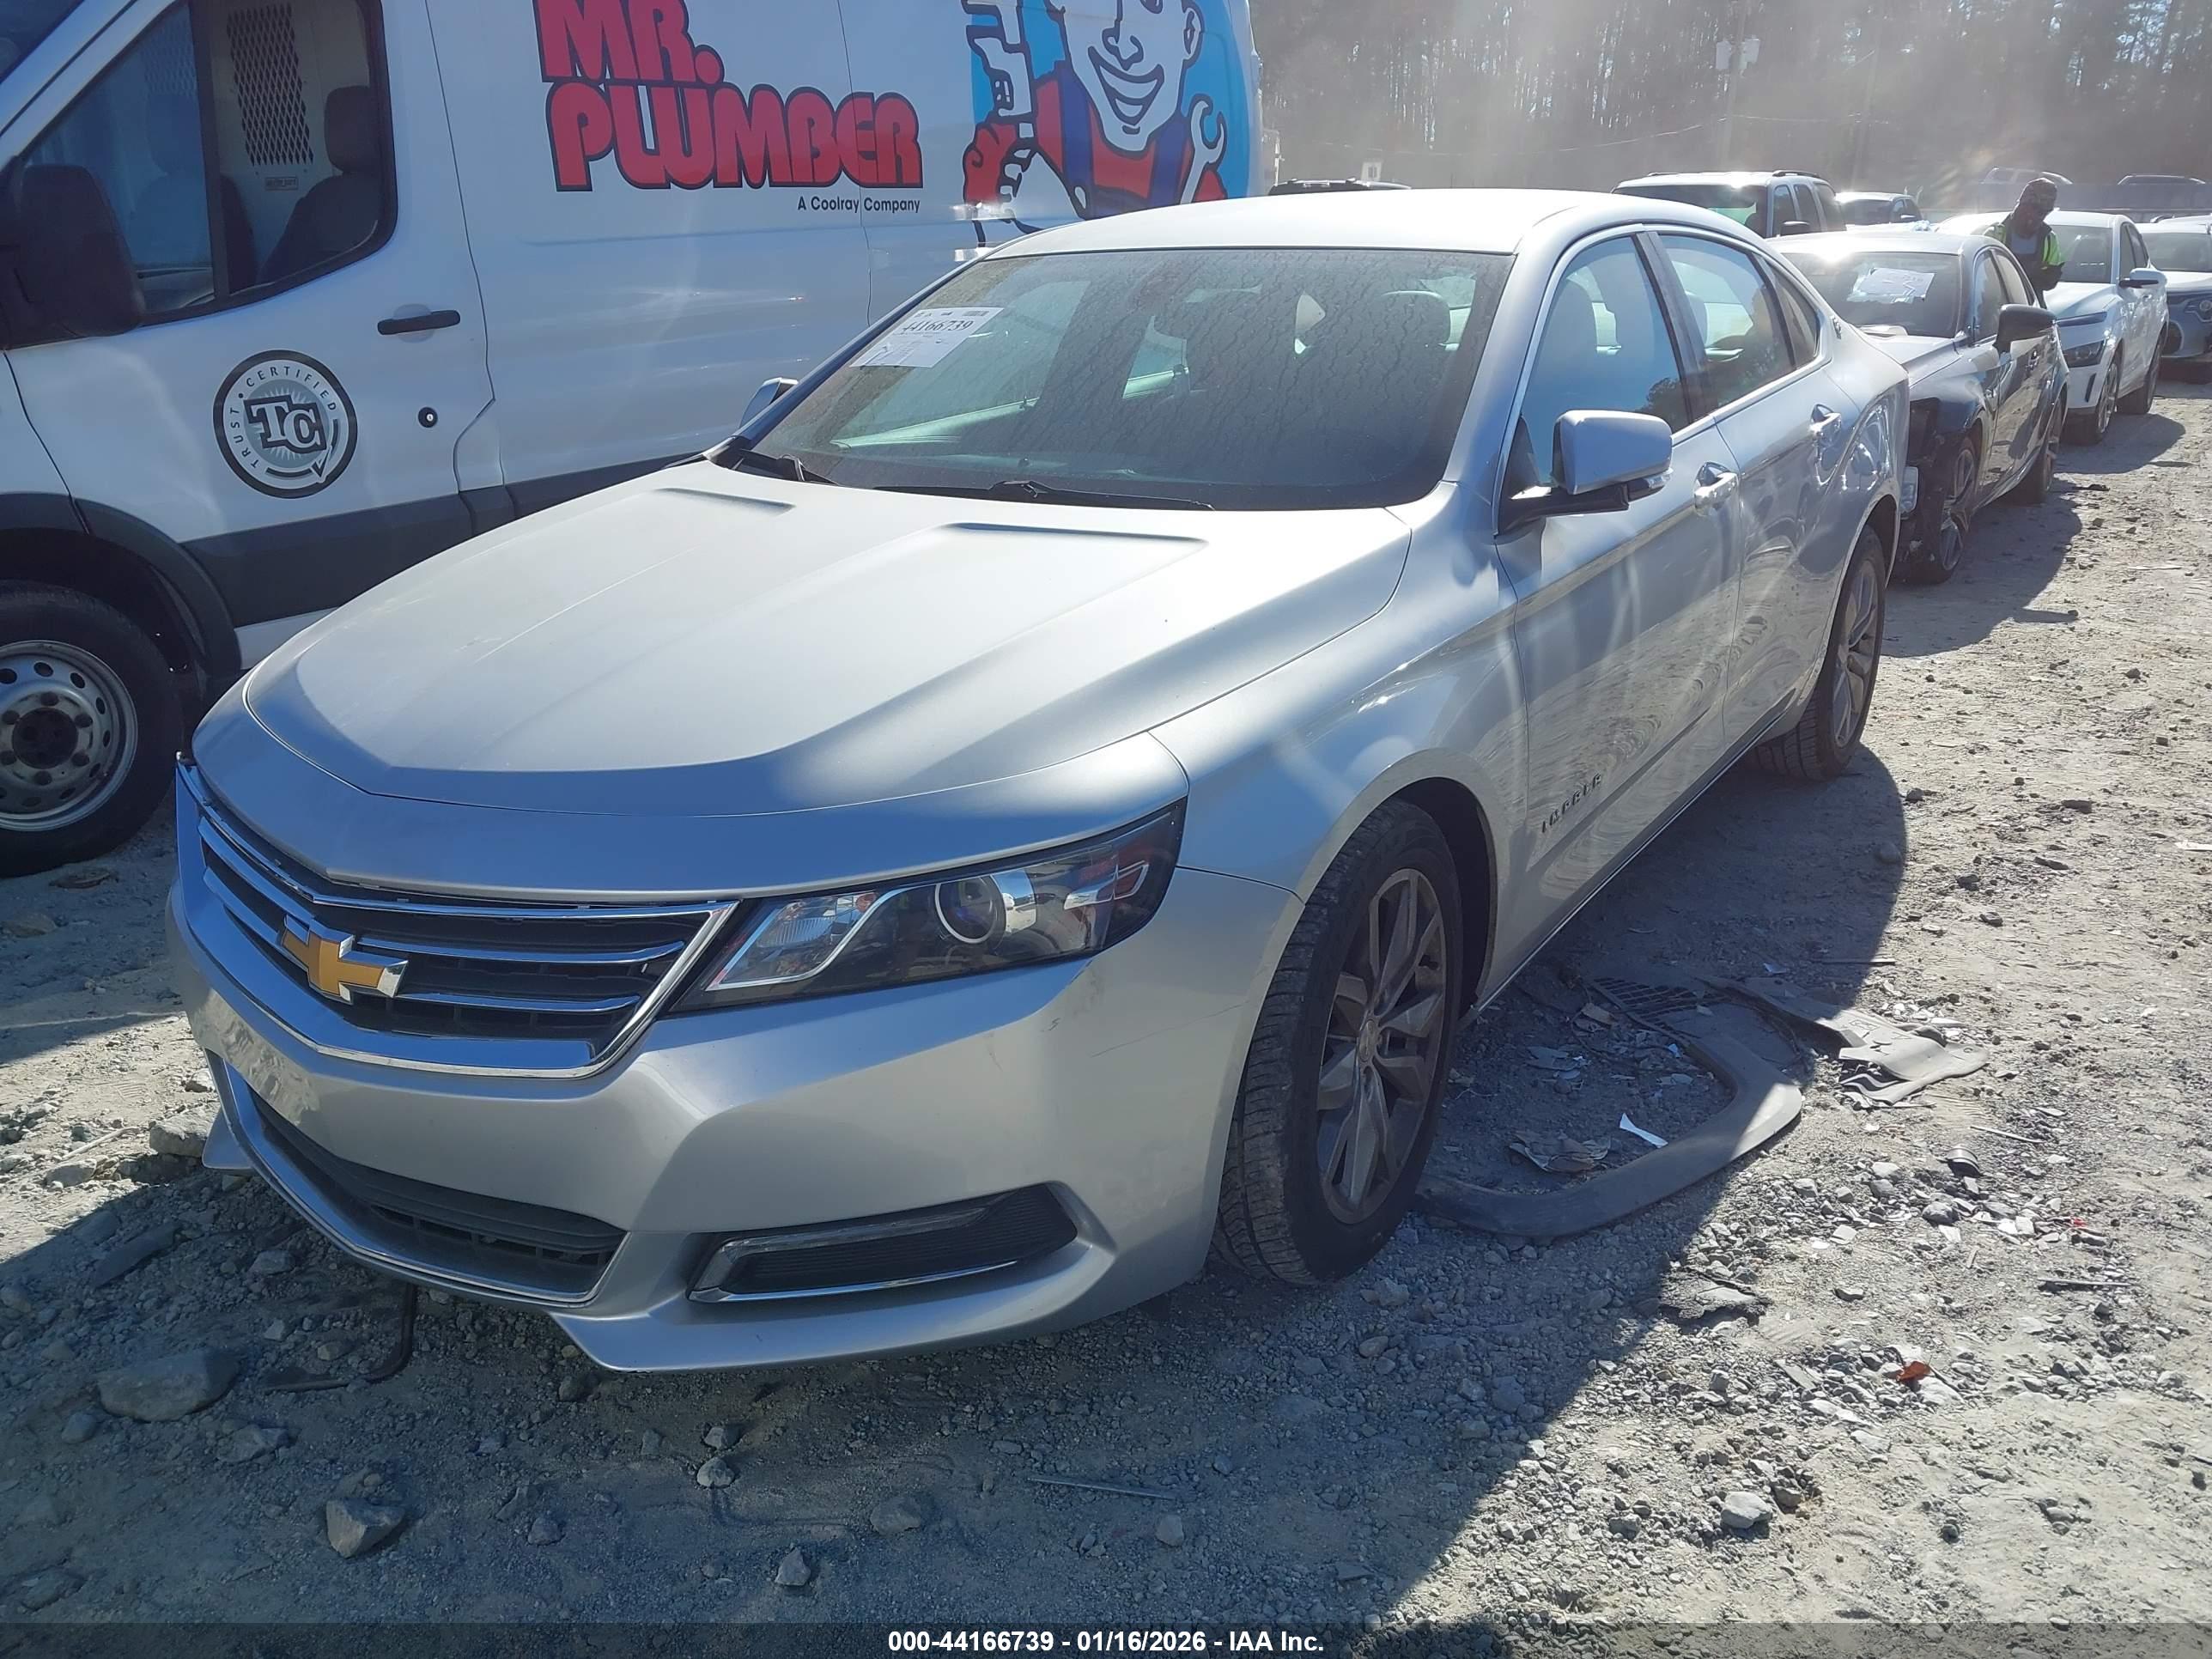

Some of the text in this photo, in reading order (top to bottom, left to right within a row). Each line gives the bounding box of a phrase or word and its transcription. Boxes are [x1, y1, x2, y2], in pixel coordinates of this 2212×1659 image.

[532, 0, 725, 84] MR.
[545, 81, 923, 192] PLUMBER
[797, 196, 921, 214] A Coolray Company
[229, 365, 337, 469] TRUST CERTIFIED
[246, 396, 325, 452] TC
